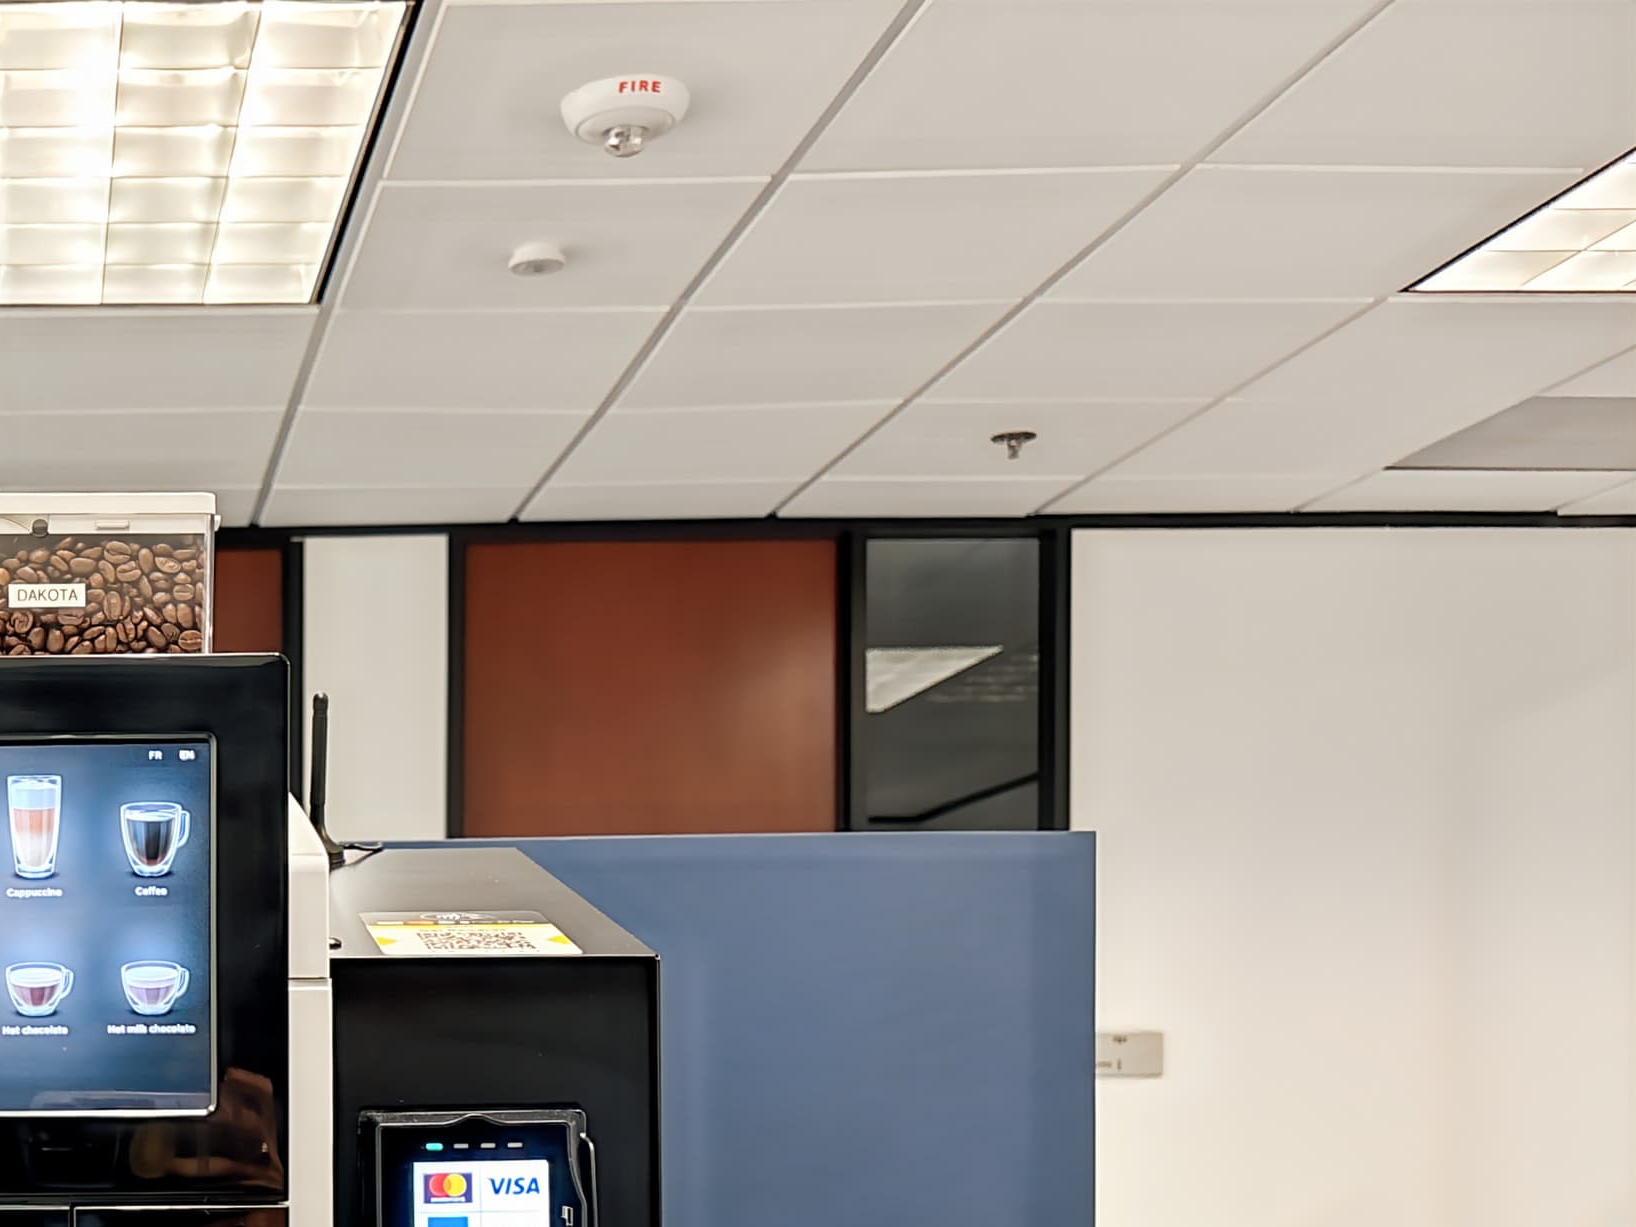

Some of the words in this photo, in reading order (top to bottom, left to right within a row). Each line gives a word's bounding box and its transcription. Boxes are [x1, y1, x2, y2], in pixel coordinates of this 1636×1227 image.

[618, 80, 661, 93] FIRE
[17, 588, 78, 601] DAKOTA
[148, 750, 163, 760] FR
[6, 888, 63, 898] Cappuccino
[135, 886, 168, 896] Coffee
[488, 1177, 540, 1195] VISA
